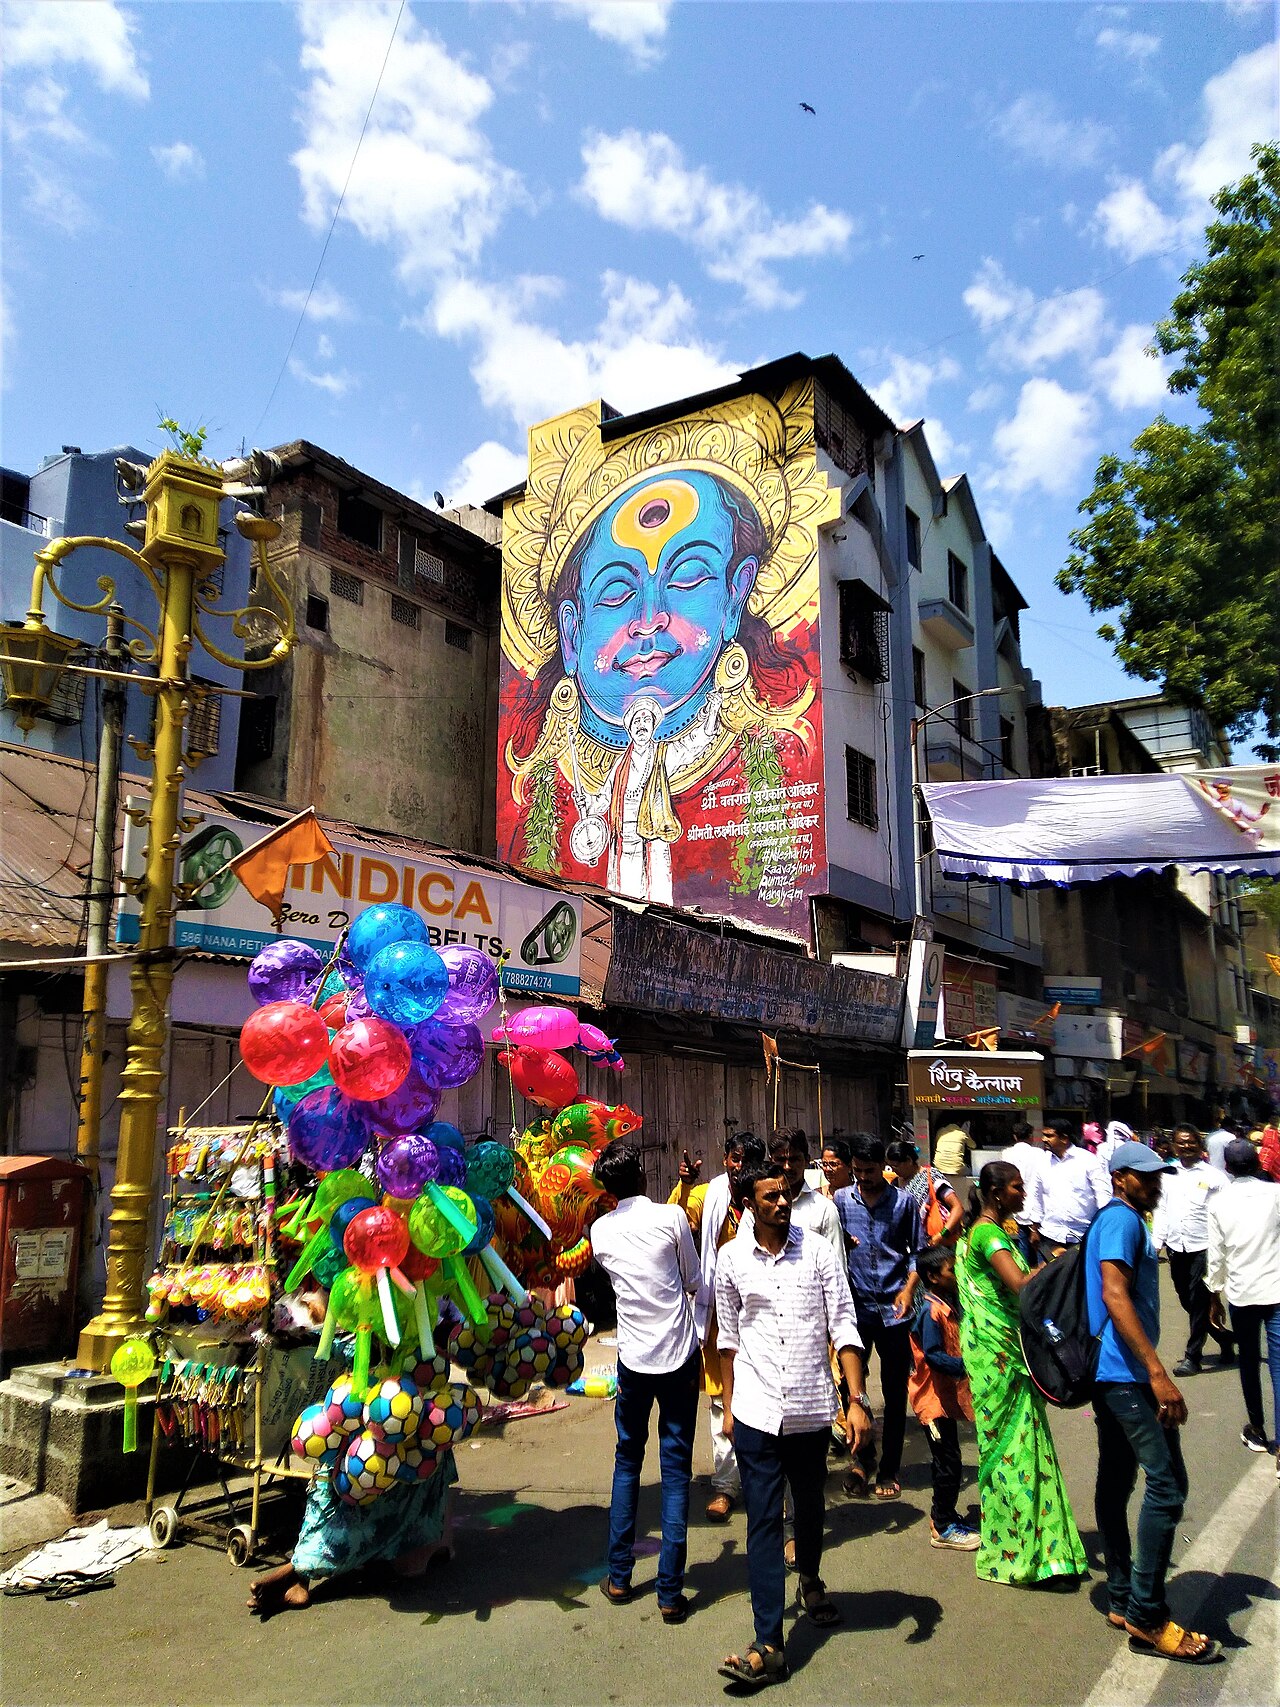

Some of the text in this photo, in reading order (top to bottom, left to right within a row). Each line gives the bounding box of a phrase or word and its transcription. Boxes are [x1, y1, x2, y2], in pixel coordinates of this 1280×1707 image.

[720, 792, 751, 807] वनराज
[271, 903, 320, 928] Zero
[180, 931, 202, 945] 586
[203, 935, 238, 949] NANA
[505, 972, 552, 989] 7888274274
[927, 1058, 1024, 1092] शिव कैलास
